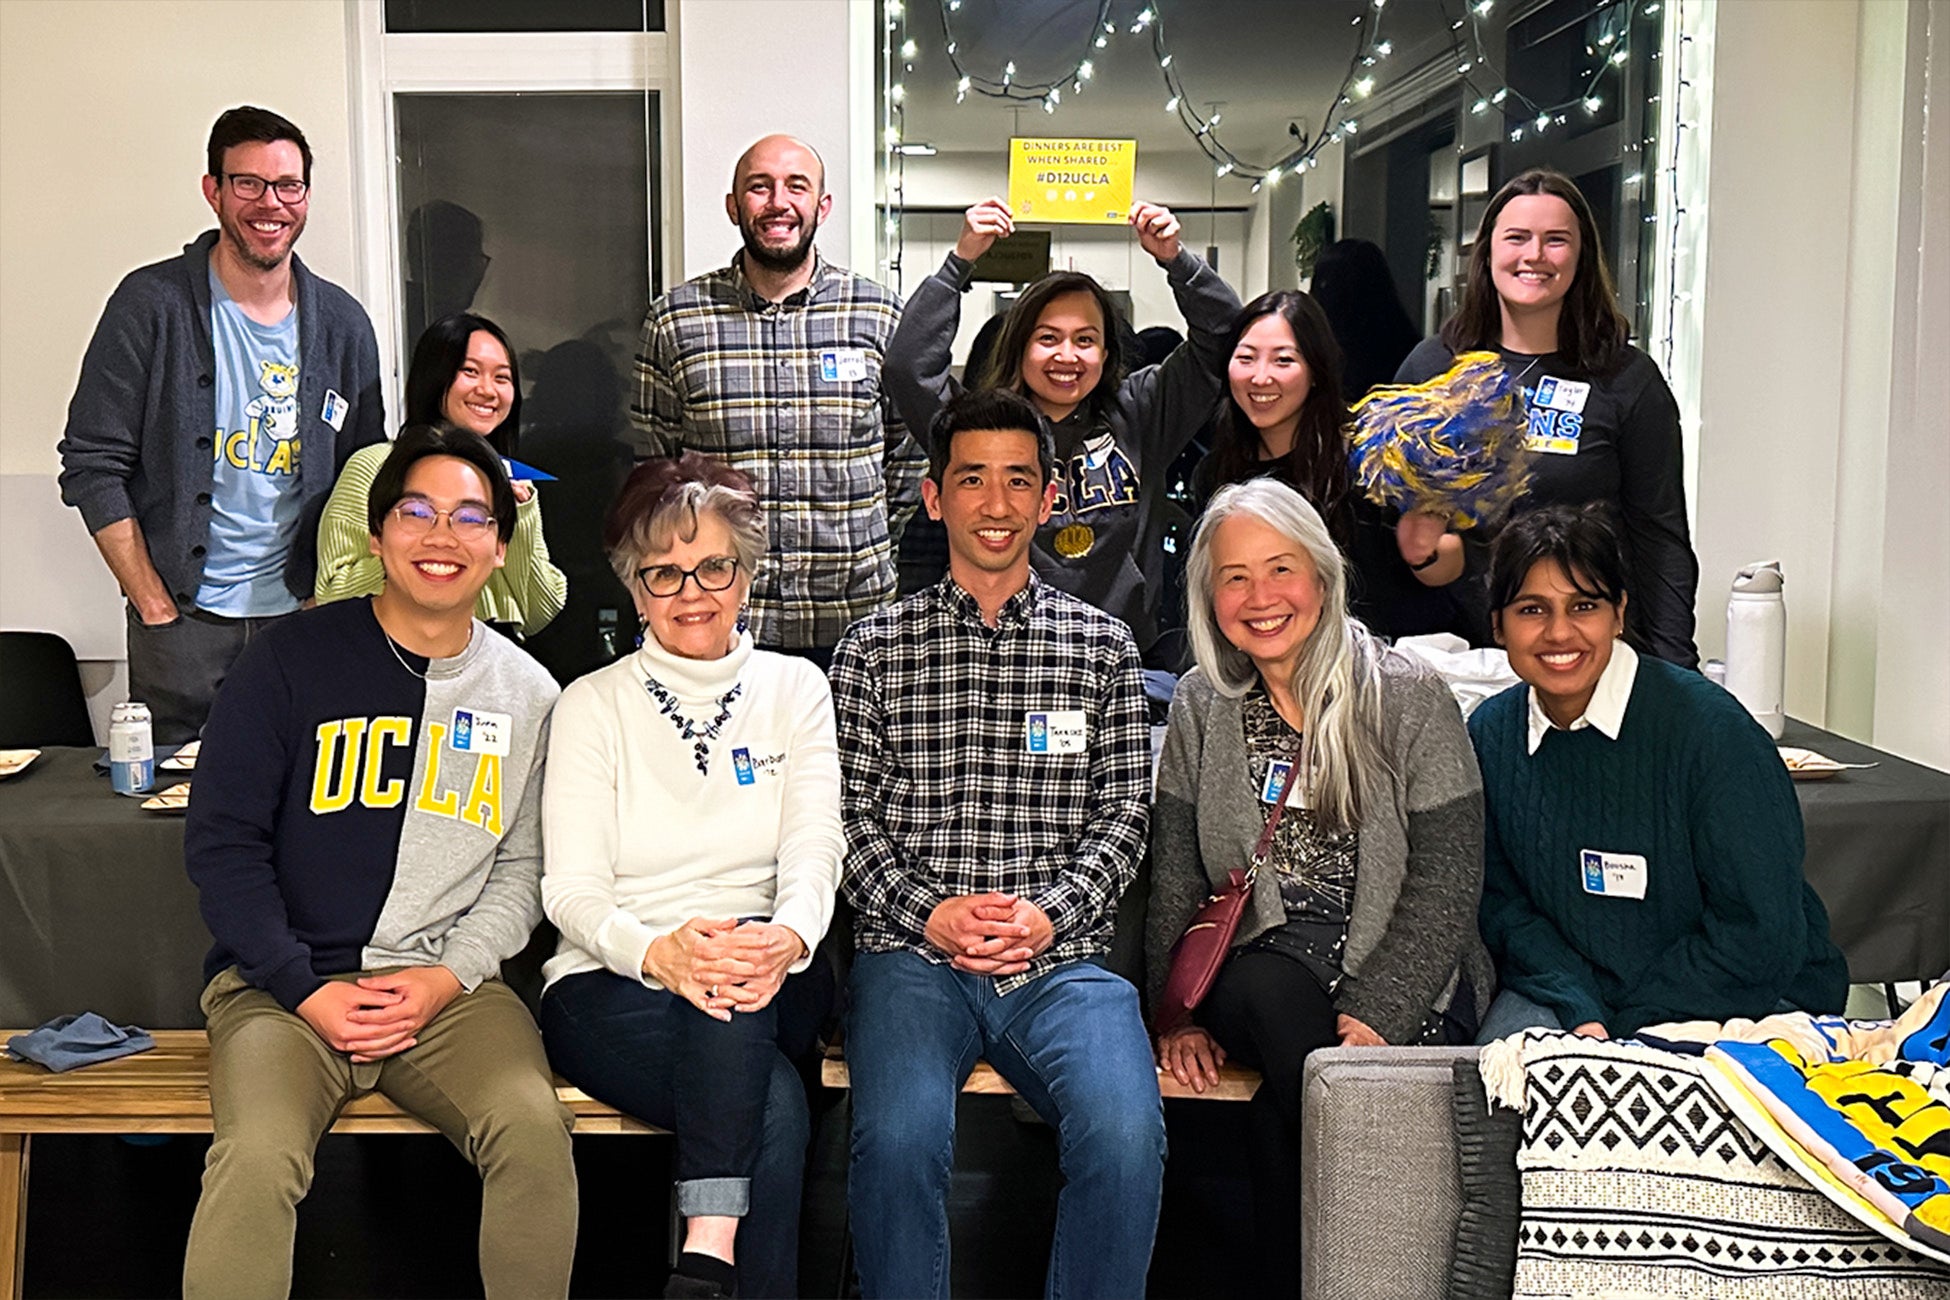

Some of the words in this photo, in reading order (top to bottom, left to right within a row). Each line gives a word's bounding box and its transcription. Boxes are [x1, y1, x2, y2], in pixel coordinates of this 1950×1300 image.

[1023, 142, 1070, 151] DINNERS
[1073, 143, 1094, 151] ARE
[1097, 143, 1123, 152] BEST
[1027, 155, 1061, 164] WHEN
[1037, 172, 1110, 185] #D12UCLA
[309, 716, 504, 840] UCLA
